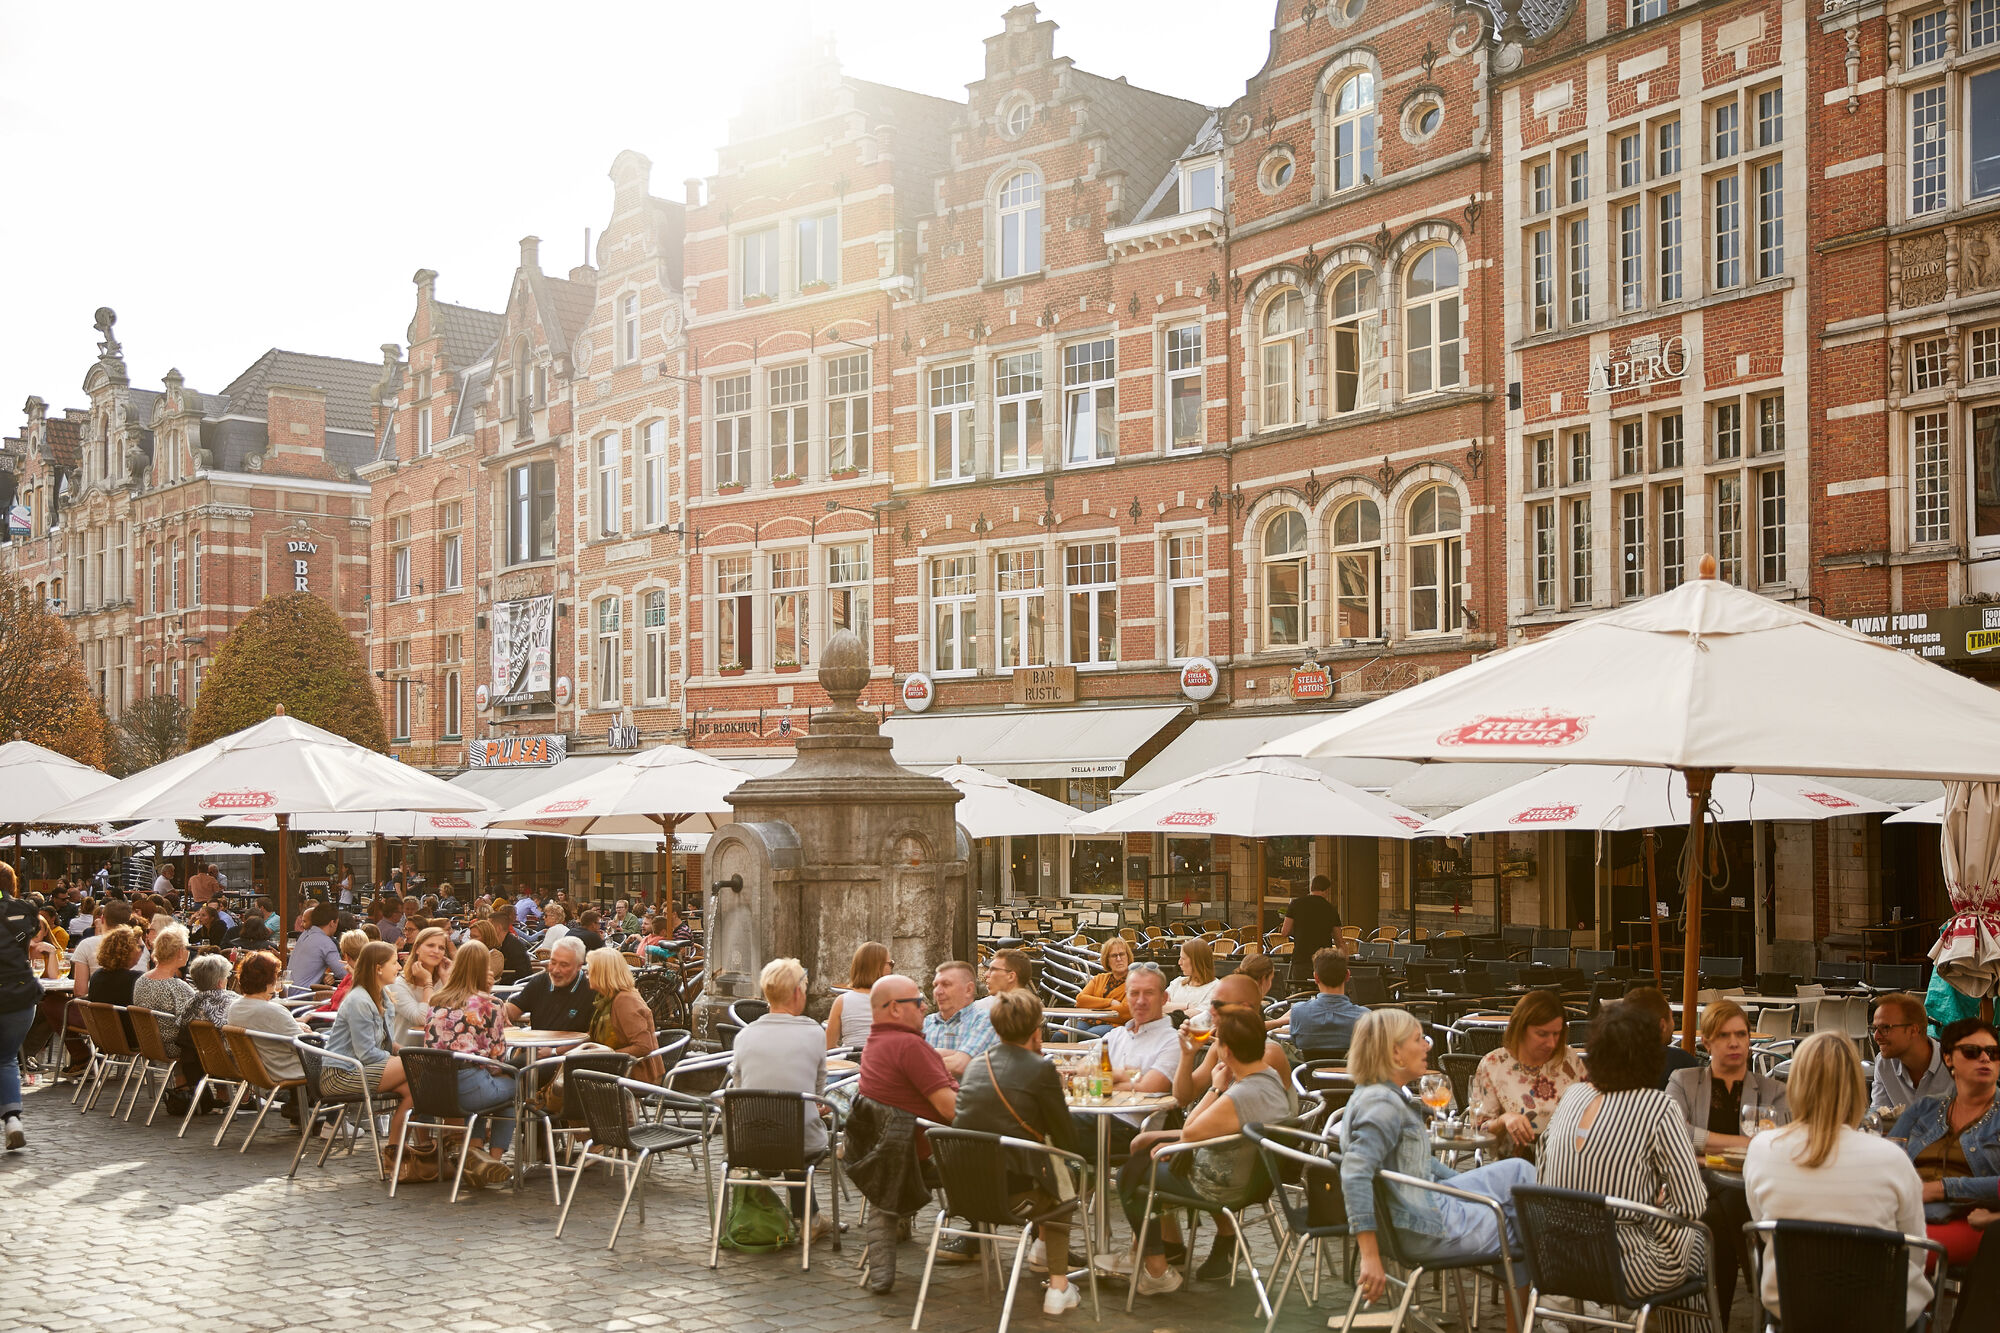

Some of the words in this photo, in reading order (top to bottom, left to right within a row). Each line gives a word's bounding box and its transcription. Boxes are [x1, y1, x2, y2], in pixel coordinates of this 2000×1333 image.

[1902, 260, 1943, 280] ADAM
[287, 541, 318, 554] DEN
[1985, 610, 2000, 618] FOO
[1852, 616, 1888, 633] AWAY
[1892, 613, 1928, 630] FOOD
[1909, 632, 1941, 644] Focacce
[1969, 632, 2000, 648] TRAN
[1922, 645, 1945, 656] Koffie
[1033, 670, 1054, 684] BAR
[1297, 676, 1323, 684] STELLA
[1025, 687, 1062, 700] RUSTIC
[1297, 684, 1324, 693] ARTOIS
[698, 724, 710, 733] DE
[713, 722, 757, 733] BLOKHUT
[1477, 721, 1568, 731] STELLA
[1464, 731, 1561, 741] ARTOIS
[486, 739, 548, 764] PLAZA
